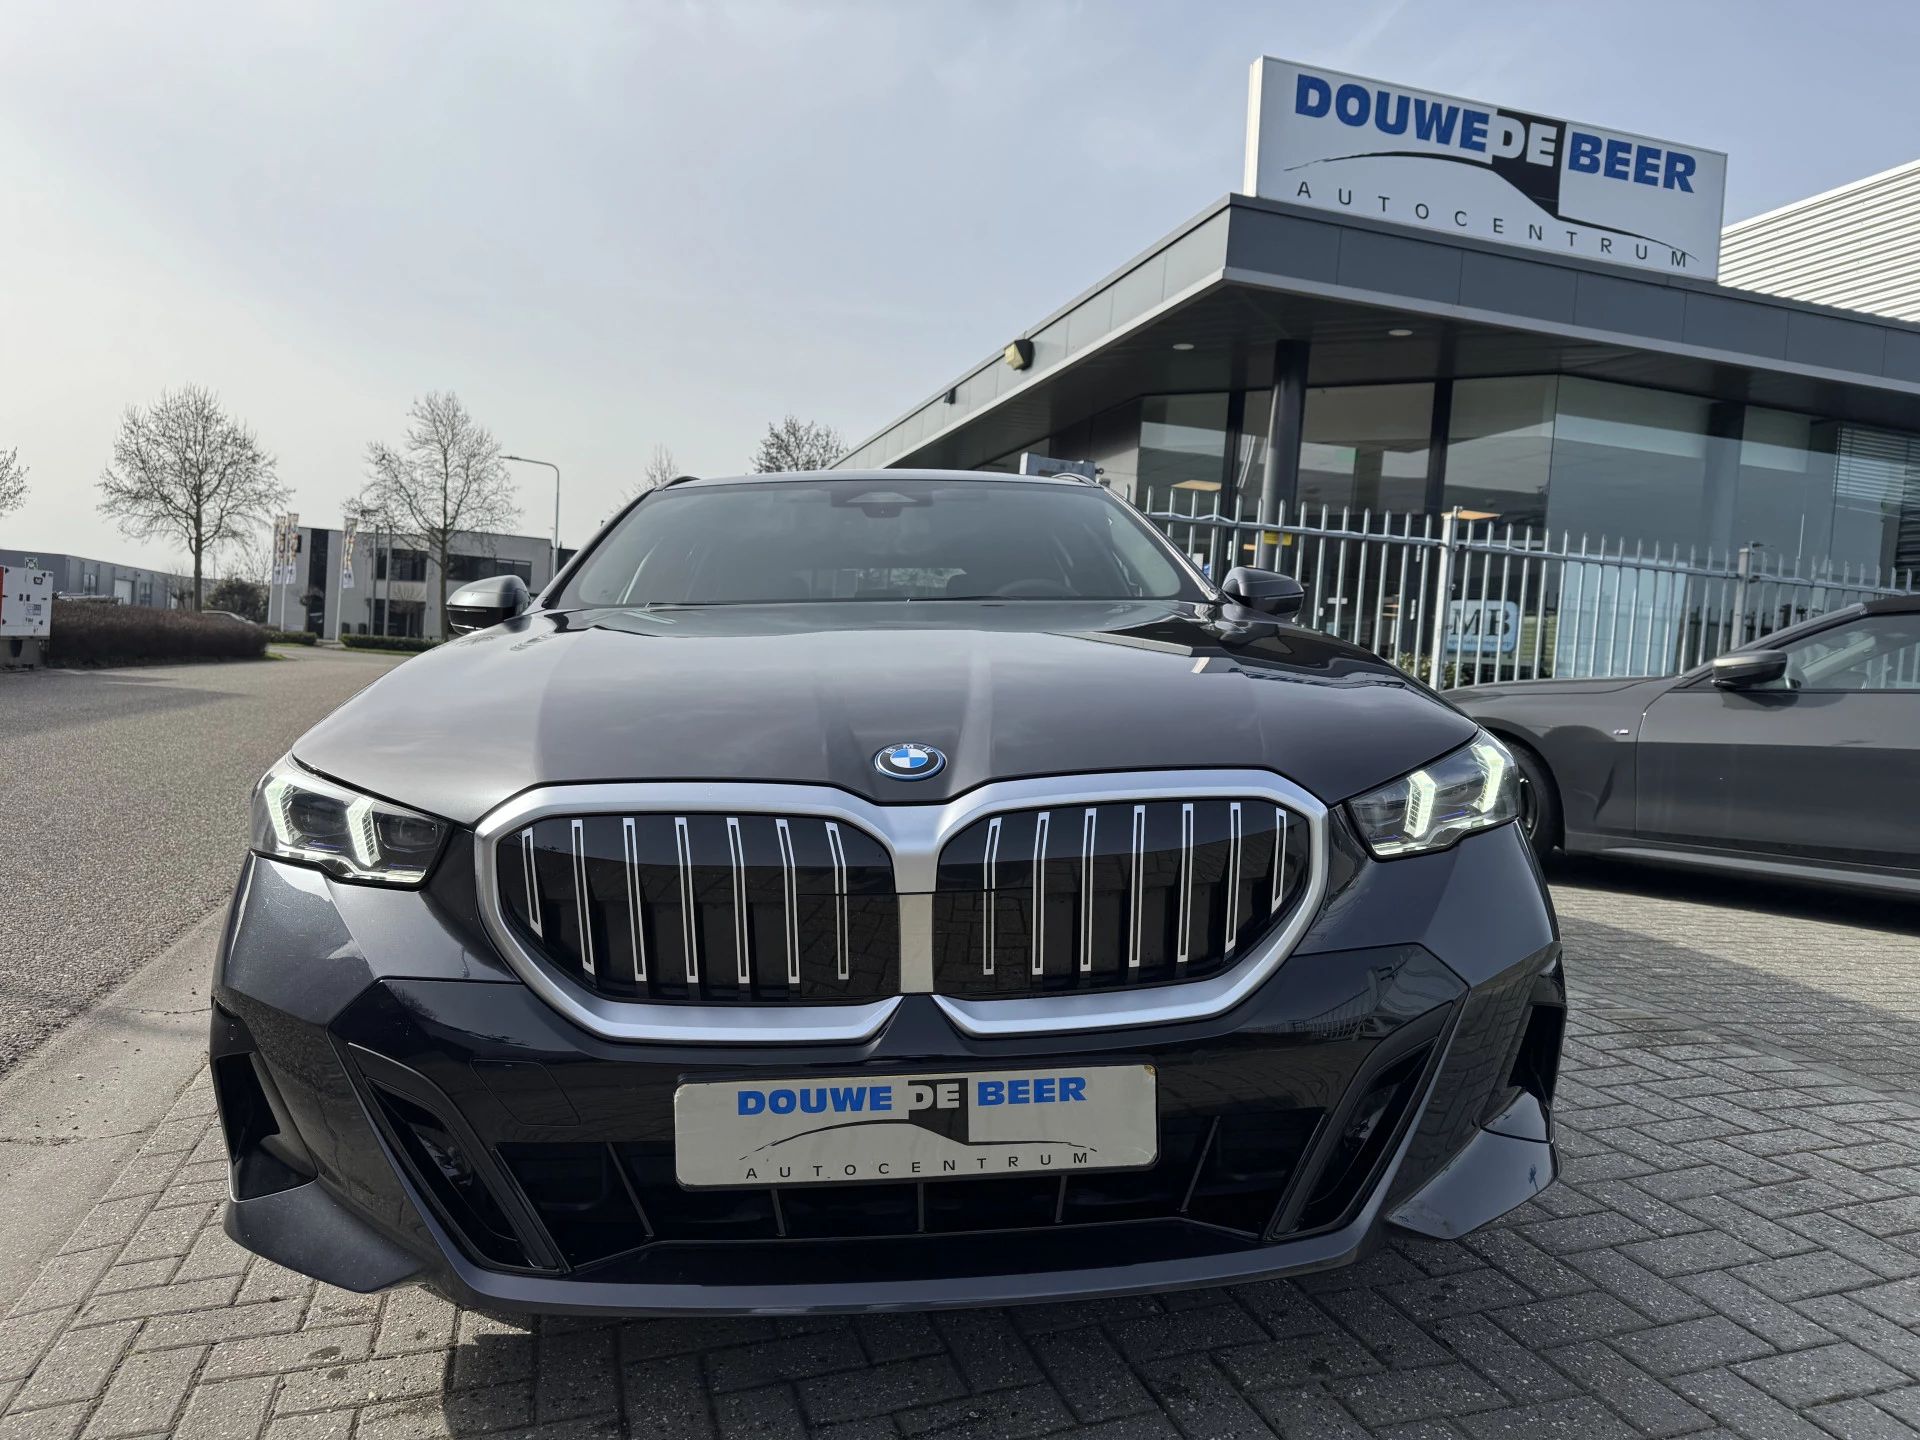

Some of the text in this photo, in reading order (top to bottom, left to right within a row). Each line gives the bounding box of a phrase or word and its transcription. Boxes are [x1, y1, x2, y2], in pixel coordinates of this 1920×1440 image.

[1295, 73, 1697, 194] DOUWE DE BEER
[1296, 180, 1687, 268] AUTOCENTRUM
[1450, 608, 1510, 636] MB
[885, 744, 934, 754] BMW
[737, 1076, 1087, 1116] DOUWE DE BEER
[745, 1152, 1088, 1180] AUTOCENTRUM
